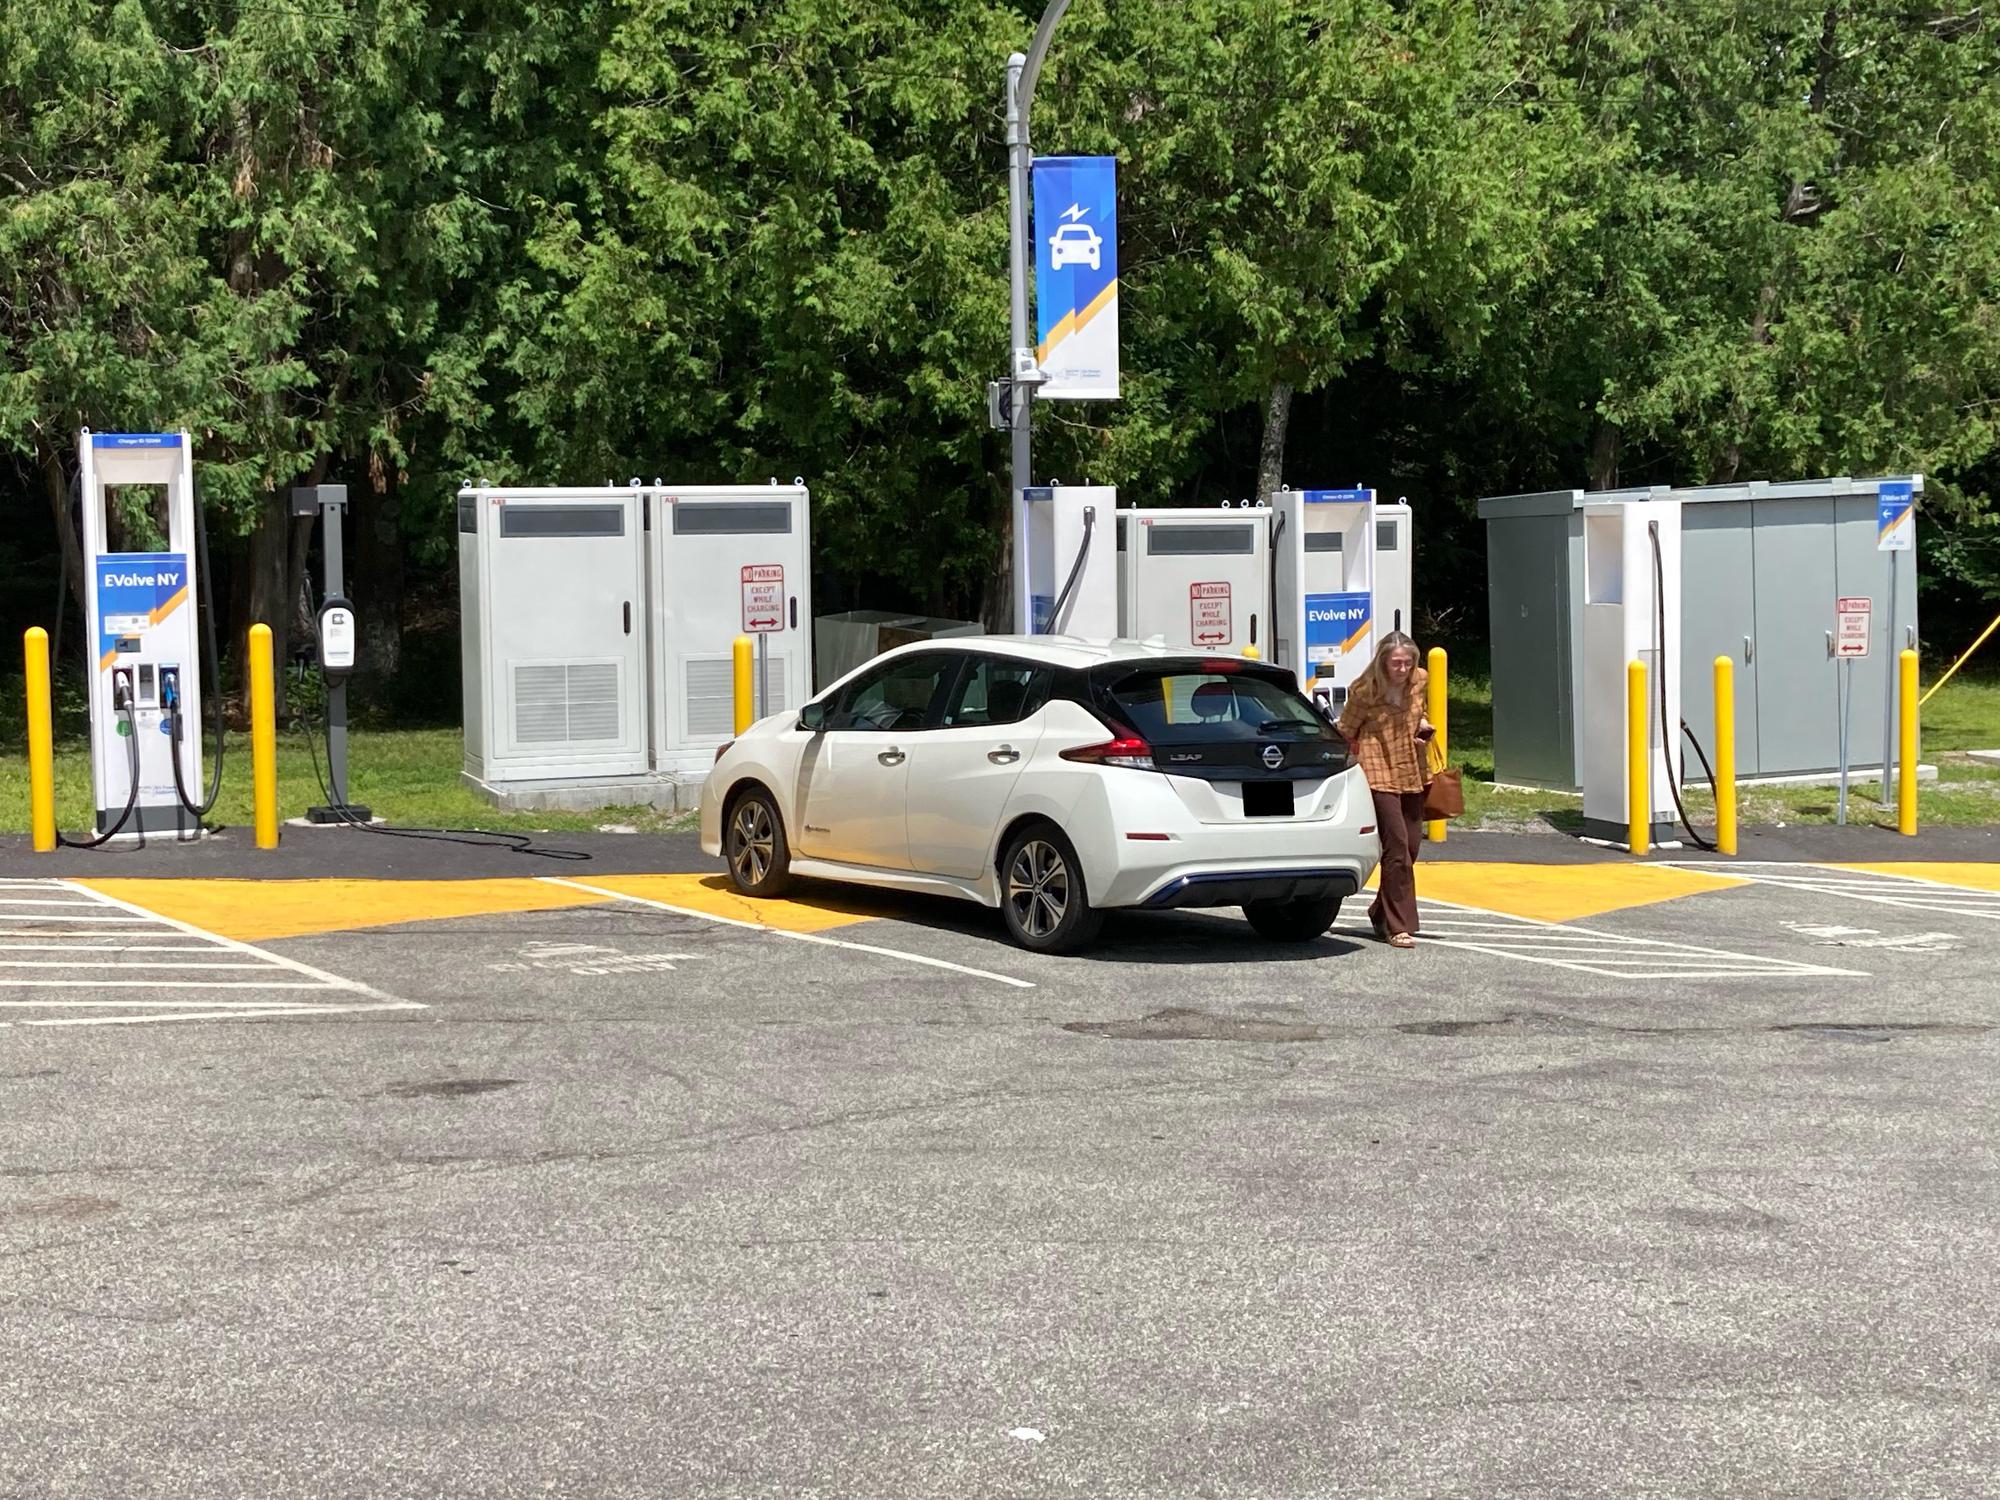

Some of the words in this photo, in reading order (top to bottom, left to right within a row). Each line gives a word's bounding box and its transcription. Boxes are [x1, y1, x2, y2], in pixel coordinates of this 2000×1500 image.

[754, 569, 781, 578] PARKING
[104, 573, 155, 587] EVolve
[157, 572, 179, 586] NY
[751, 586, 776, 594] EXCEPT
[1202, 586, 1229, 595] PARKING
[753, 595, 773, 603] WHILE
[747, 604, 780, 613] CHARGING
[1200, 601, 1223, 610] EXCEPT
[1202, 610, 1220, 618] WHILE
[1309, 608, 1347, 621] EVolve
[1348, 607, 1365, 620] NY
[1195, 619, 1228, 627] CHARGING
